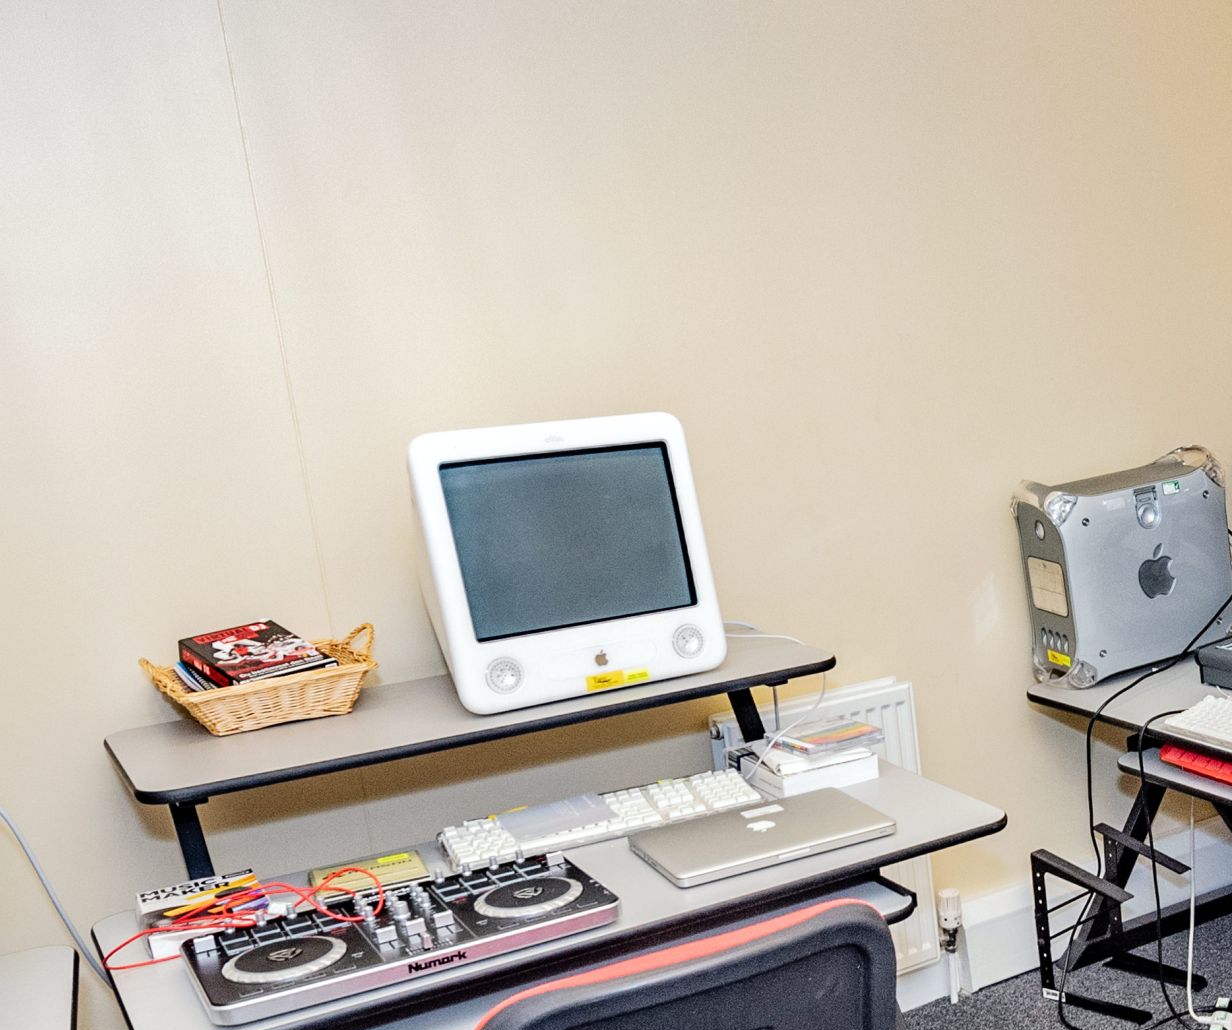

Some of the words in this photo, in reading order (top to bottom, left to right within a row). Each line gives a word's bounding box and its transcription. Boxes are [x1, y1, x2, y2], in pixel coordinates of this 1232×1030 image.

[140, 878, 217, 899] MUSIC
[141, 881, 231, 903] MAKER
[407, 951, 468, 974] Numark
